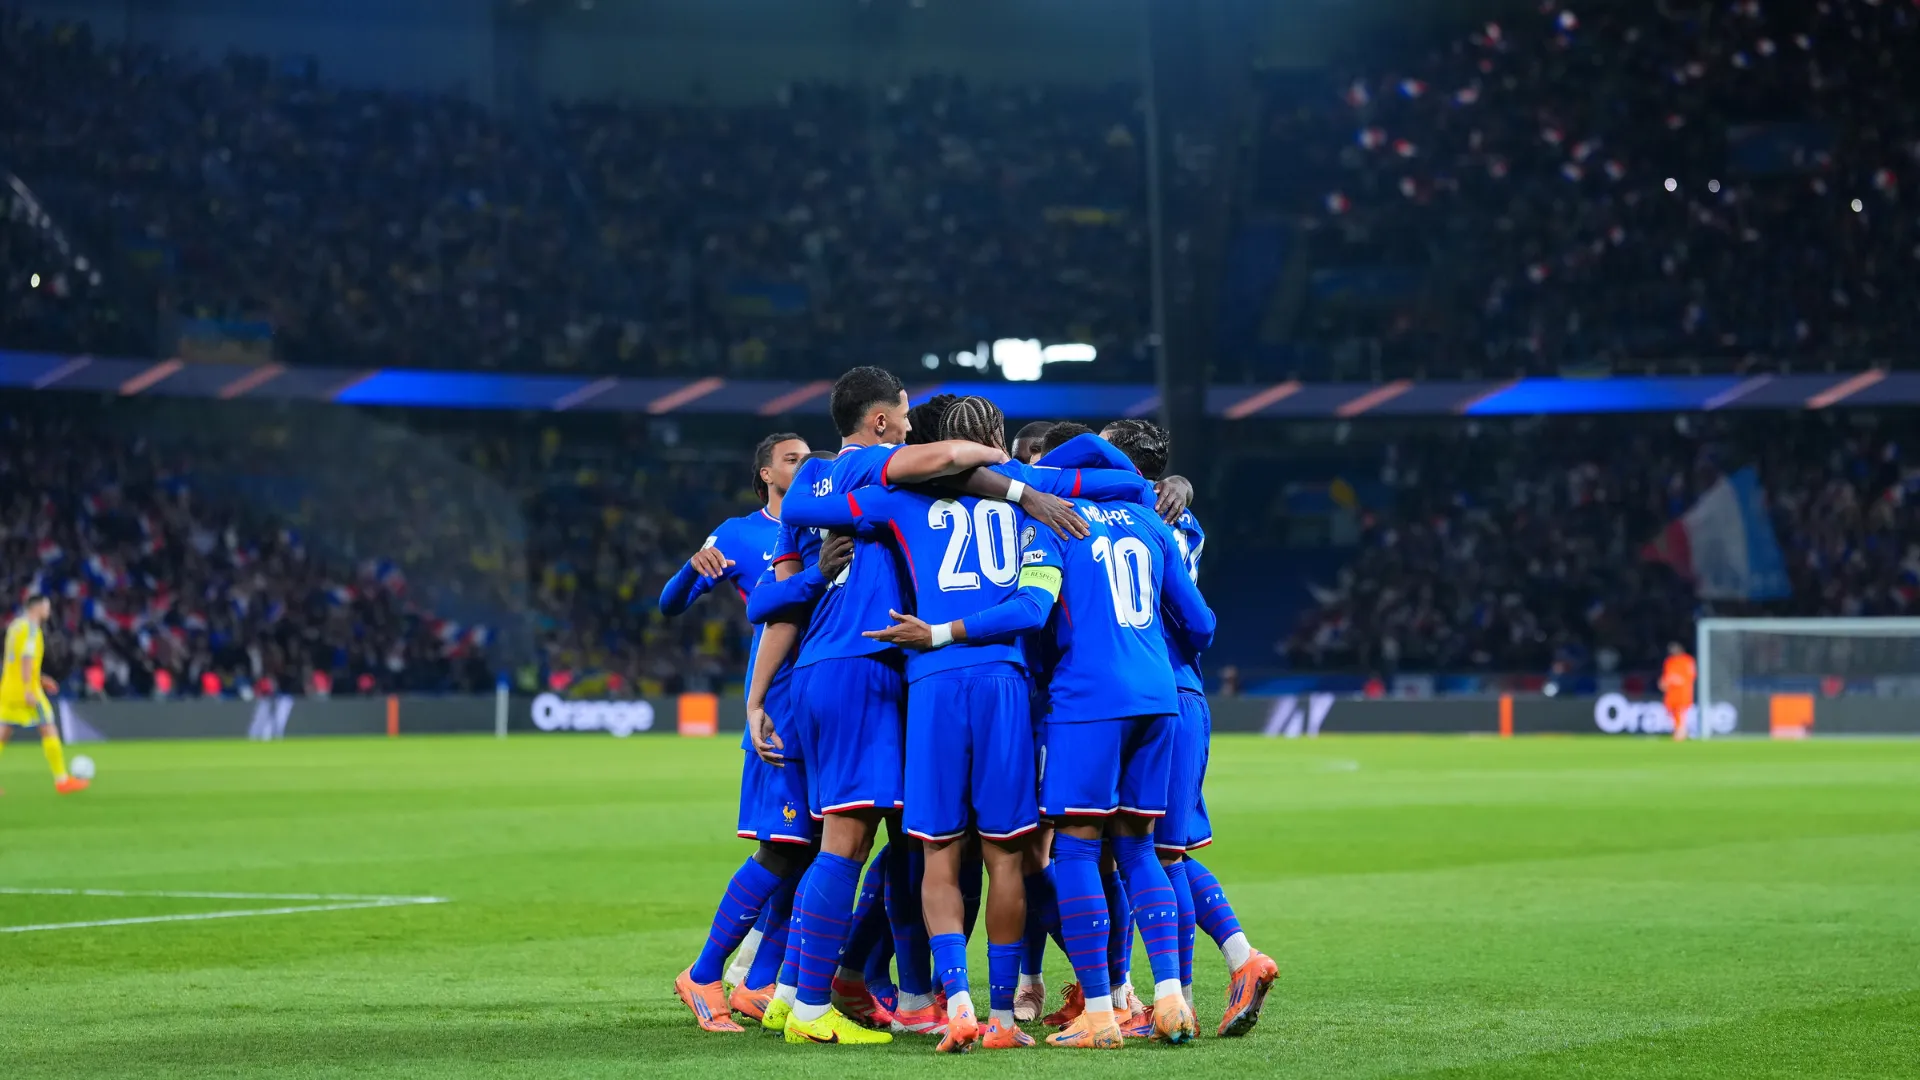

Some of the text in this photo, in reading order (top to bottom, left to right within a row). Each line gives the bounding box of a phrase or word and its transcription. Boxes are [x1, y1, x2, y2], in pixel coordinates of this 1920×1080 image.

[928, 498, 1019, 592] 20
[1091, 536, 1154, 629] 10
[531, 692, 655, 738] Orange
